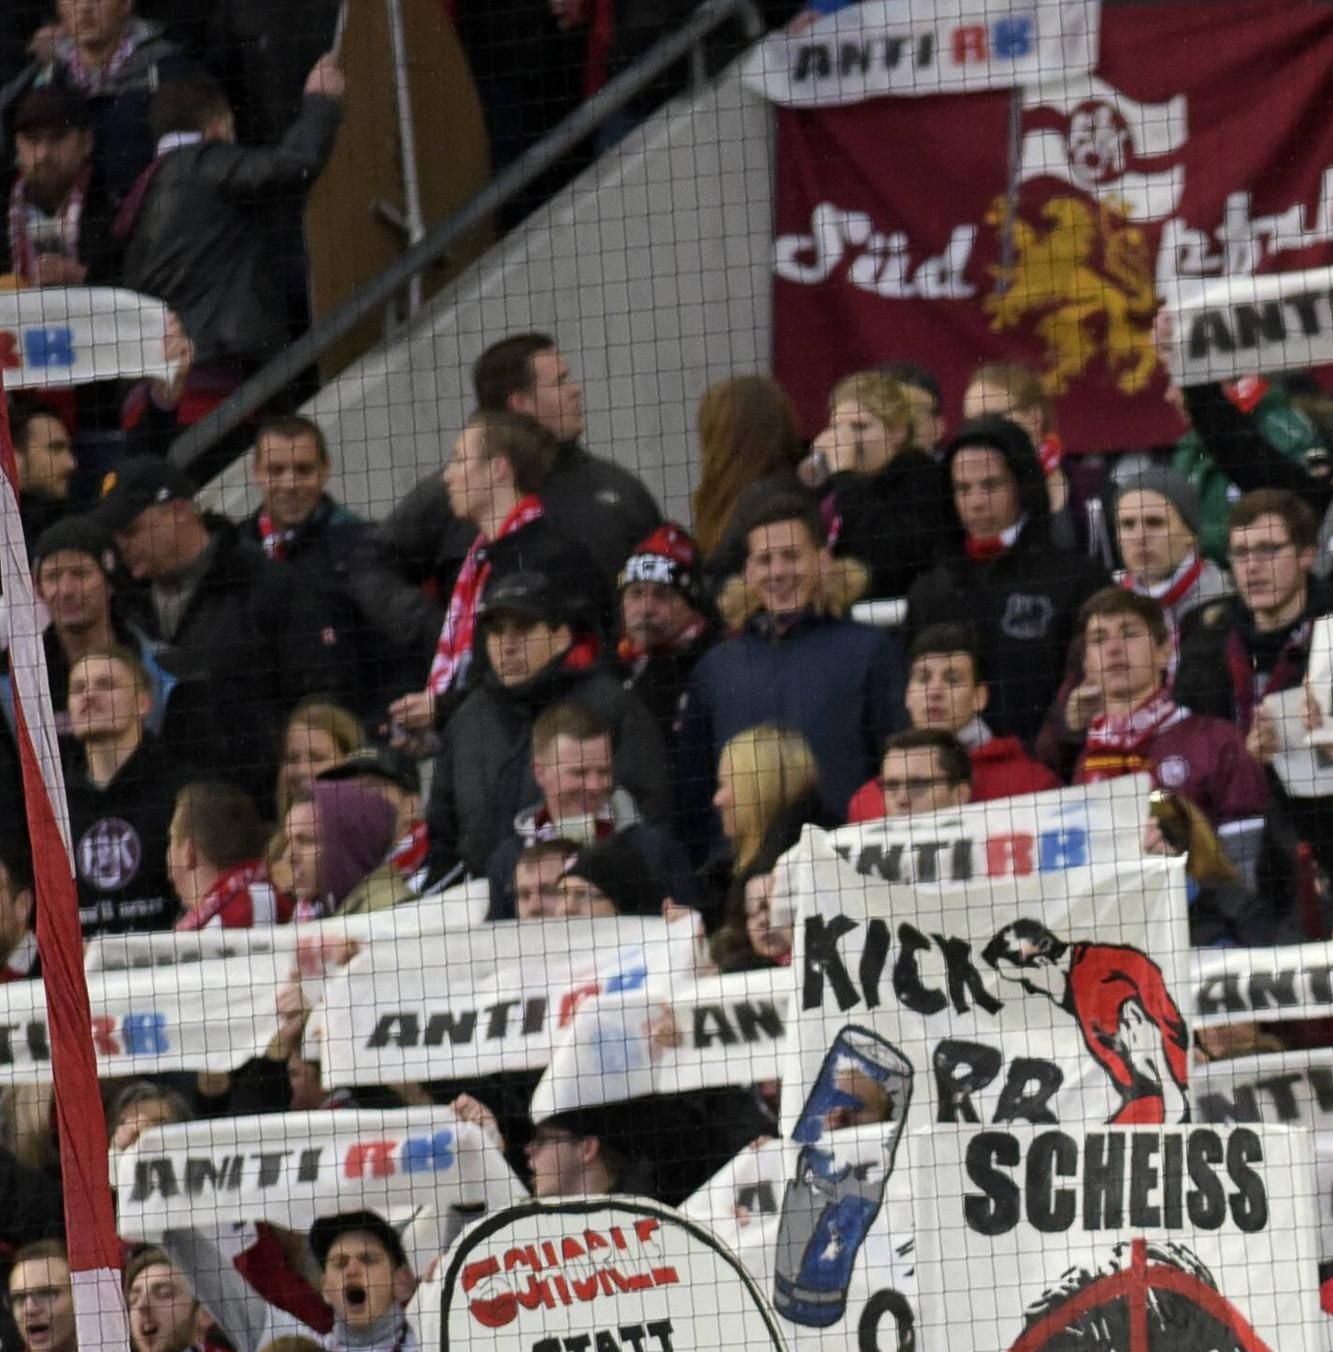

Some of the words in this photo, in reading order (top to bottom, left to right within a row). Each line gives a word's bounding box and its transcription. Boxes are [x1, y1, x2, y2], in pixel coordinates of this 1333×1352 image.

[794, 33, 934, 81] ANTI
[950, 17, 1033, 64] RB
[773, 202, 978, 299] Süd
[987, 828, 1088, 878] RB
[802, 913, 1005, 1016] KICK
[366, 998, 550, 1050] ANTI
[132, 1146, 321, 1201] ANTI
[344, 1130, 455, 1178] RB
[964, 1126, 1269, 1236] SCHEISS
